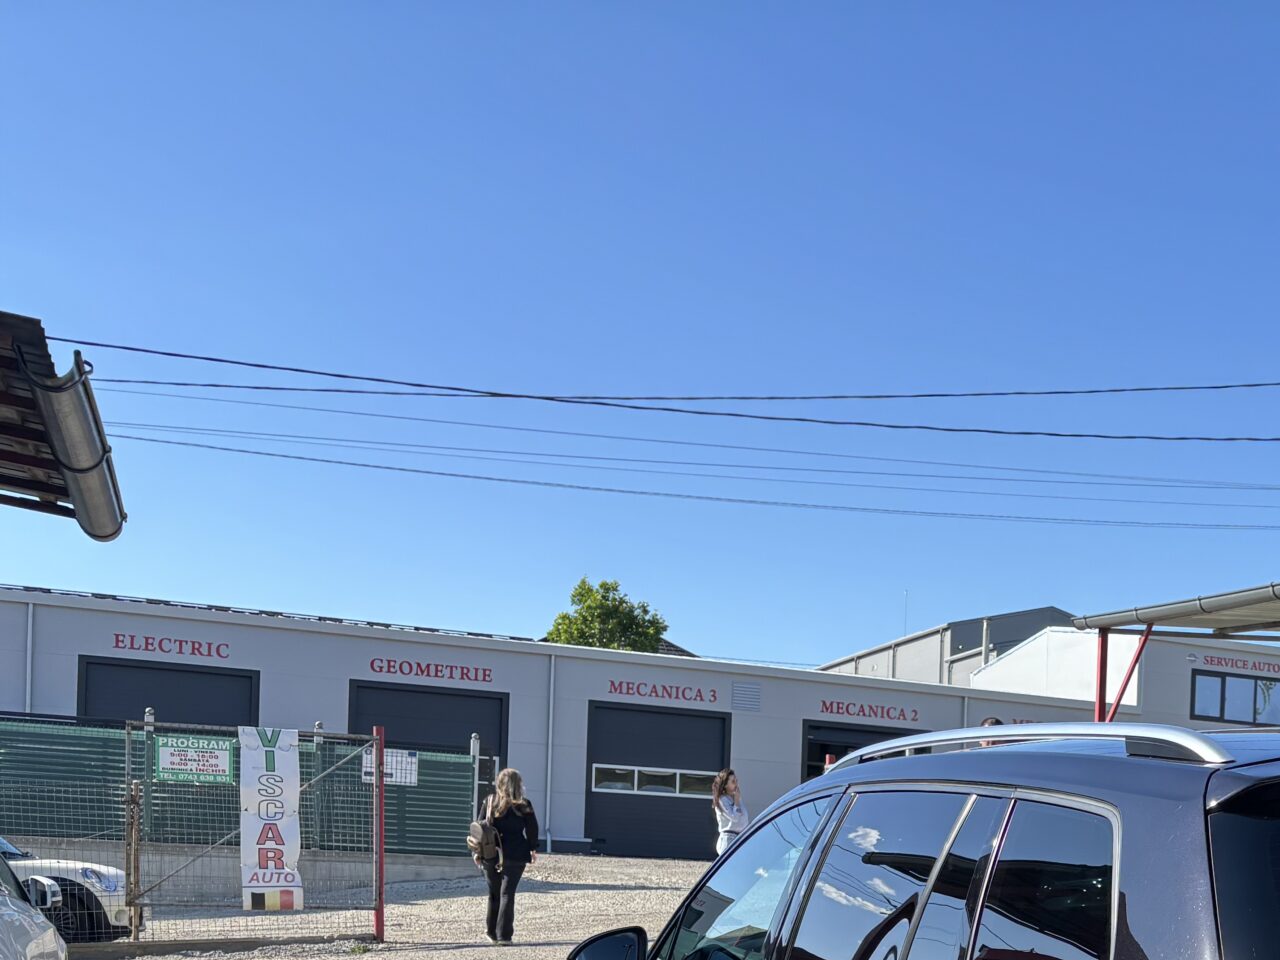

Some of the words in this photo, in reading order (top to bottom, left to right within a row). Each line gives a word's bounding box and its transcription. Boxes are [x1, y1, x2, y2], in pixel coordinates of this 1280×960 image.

[112, 633, 230, 660] ELECTRIC
[369, 657, 493, 682] GEOMETRIE
[1203, 655, 1249, 670] SERVICE
[1251, 661, 1280, 673] AUTO
[608, 680, 704, 702] MECANICA
[709, 689, 717, 703] 3
[820, 700, 907, 721] MECANICA
[910, 708, 919, 722] 2
[159, 737, 230, 750] PROGRAM
[248, 871, 296, 884] AUTO
